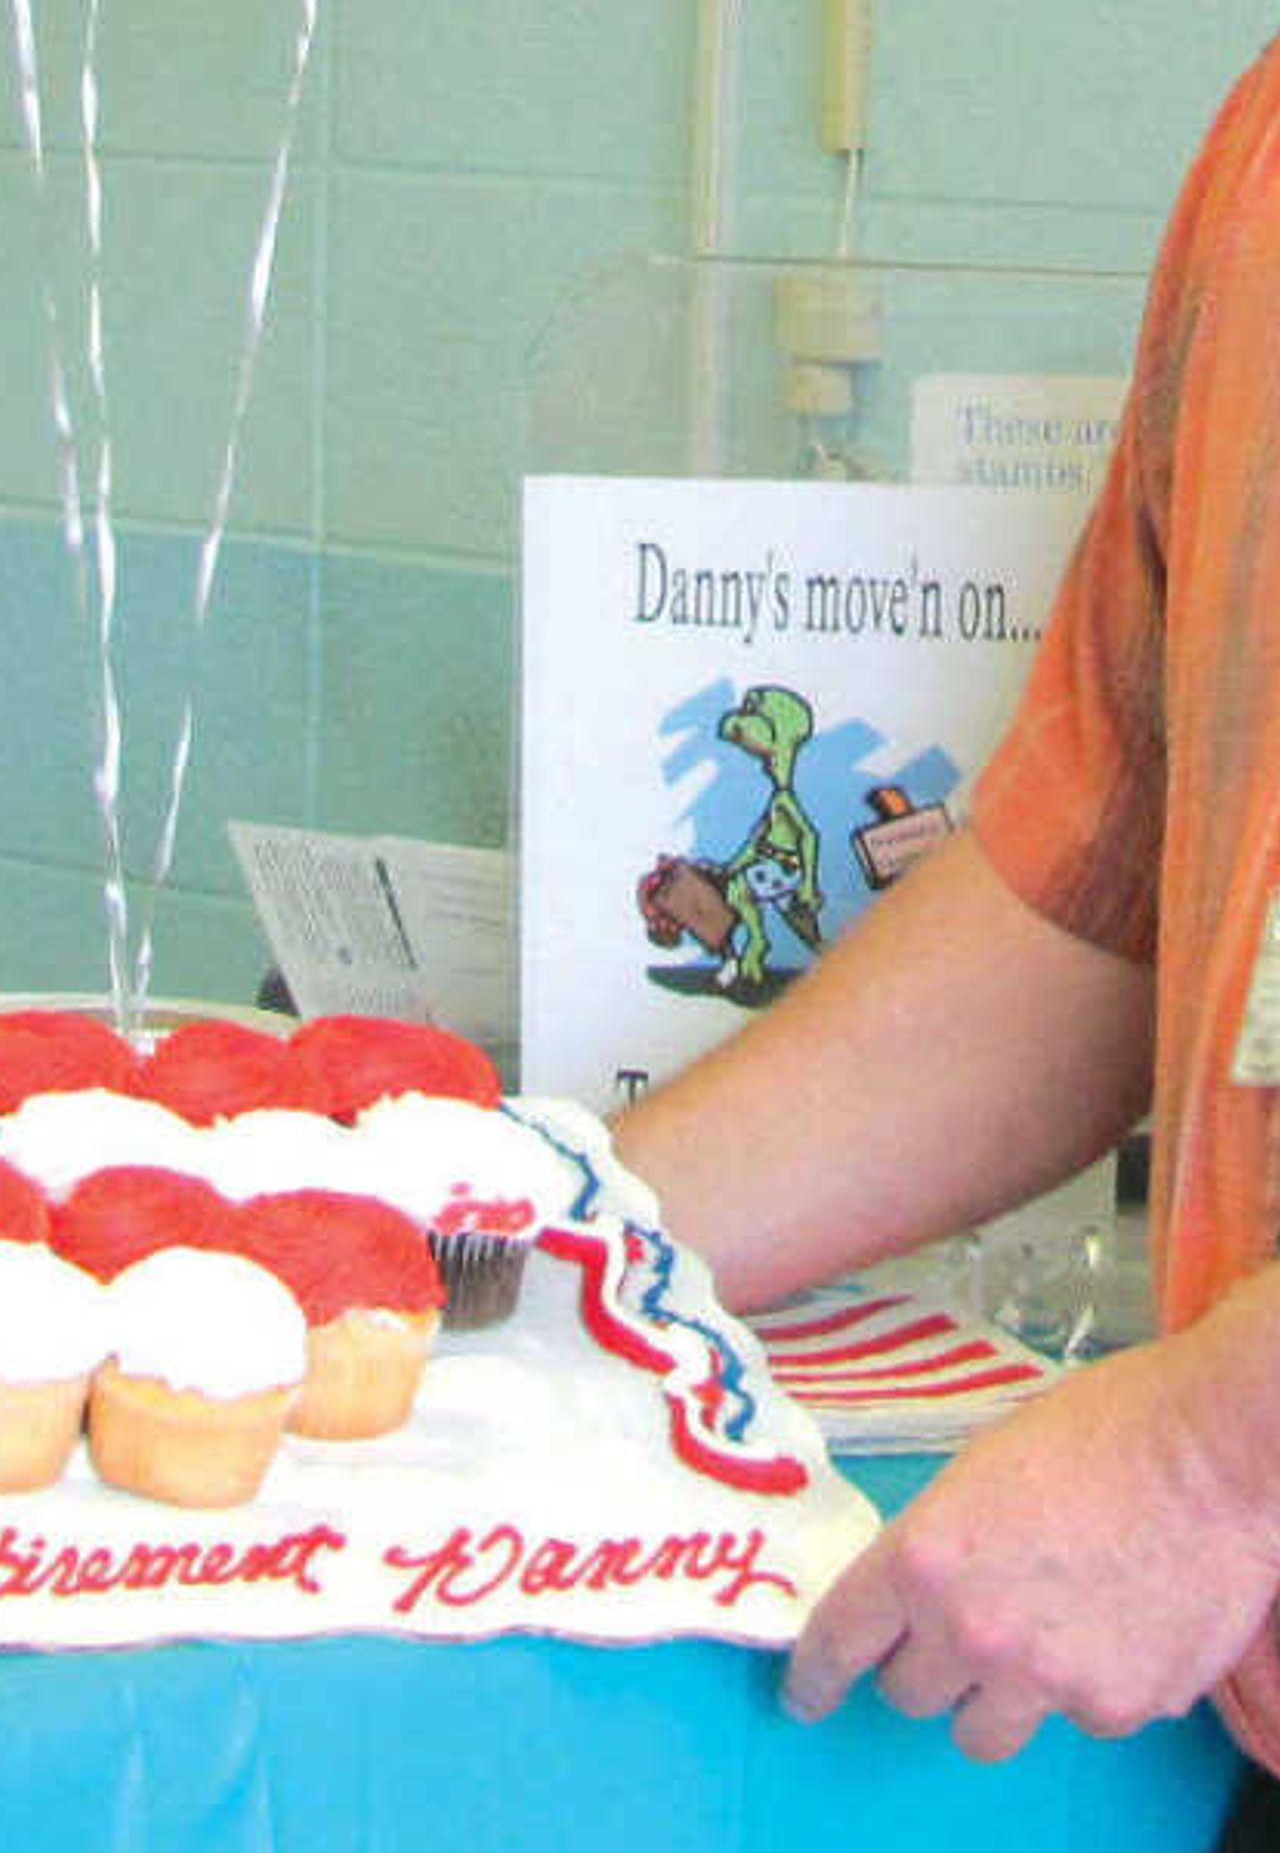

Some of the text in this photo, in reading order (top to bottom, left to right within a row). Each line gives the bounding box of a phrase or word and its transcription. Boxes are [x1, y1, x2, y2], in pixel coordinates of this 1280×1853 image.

[955, 401, 1066, 446] These
[632, 542, 1042, 643] Danny's move'n on...
[382, 1523, 799, 1614] Danny
